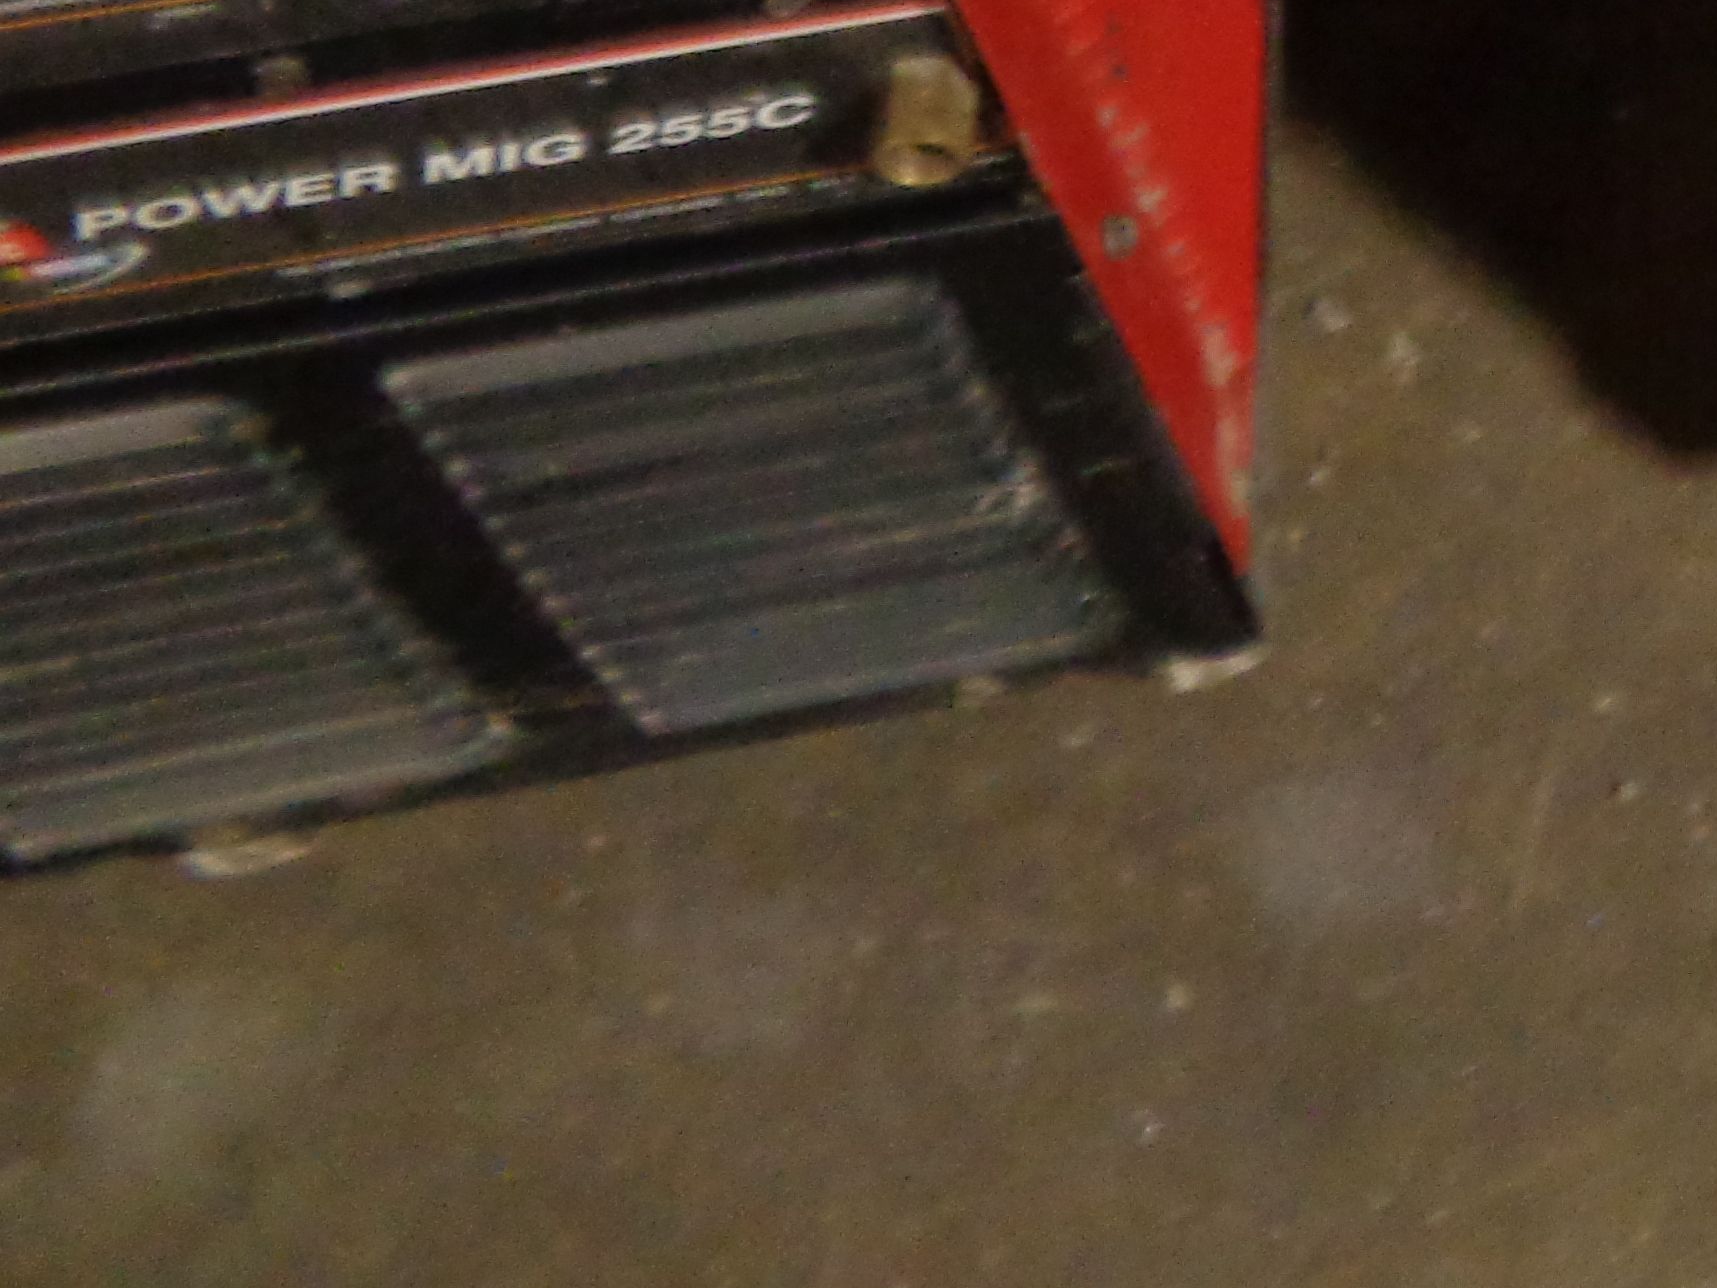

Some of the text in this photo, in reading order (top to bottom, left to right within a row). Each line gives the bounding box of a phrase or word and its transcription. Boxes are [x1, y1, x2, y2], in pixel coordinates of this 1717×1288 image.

[71, 159, 398, 241] POWER
[421, 130, 588, 188] MIG
[607, 91, 818, 157] 255C
